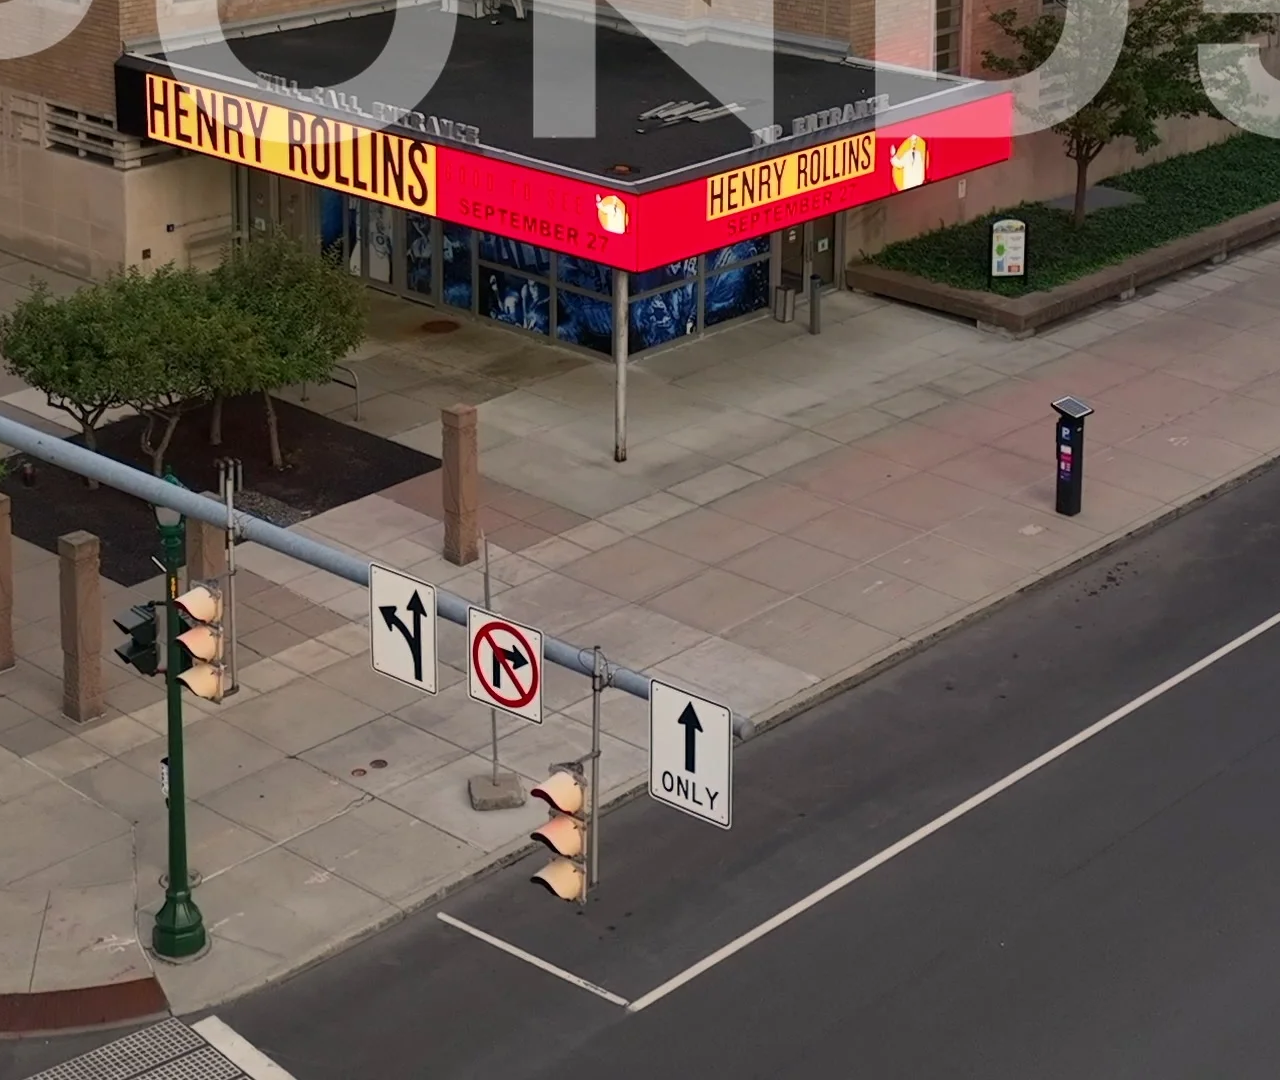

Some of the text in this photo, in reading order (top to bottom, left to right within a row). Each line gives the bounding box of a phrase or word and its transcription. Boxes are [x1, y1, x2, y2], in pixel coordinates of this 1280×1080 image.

[371, 100, 481, 146] ENTRANCE
[792, 93, 891, 136] ENTRANCE
[148, 76, 269, 164] HENRY
[287, 110, 429, 207] ROLLINS
[710, 134, 872, 217] HENRY ROLLINS
[458, 196, 610, 253] SEPTEMBER 27
[727, 190, 833, 237] SEPTEMBER
[662, 770, 719, 810] ONLY
